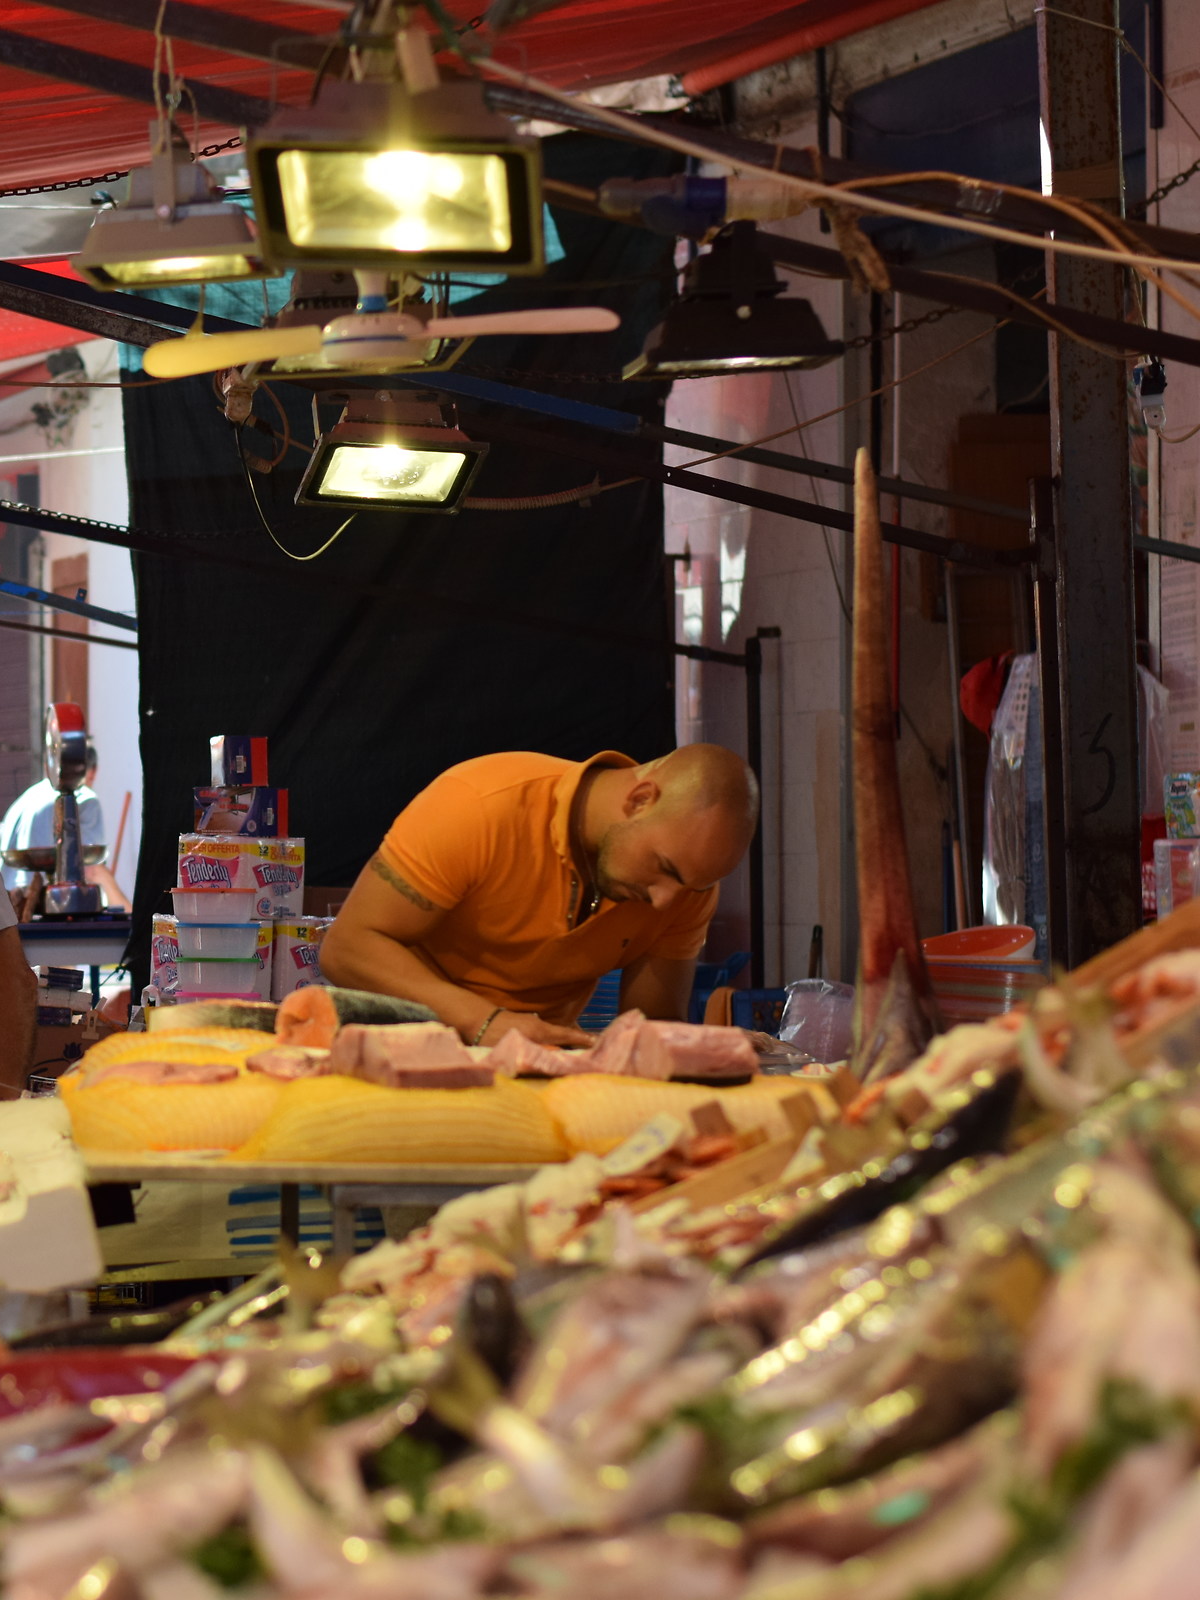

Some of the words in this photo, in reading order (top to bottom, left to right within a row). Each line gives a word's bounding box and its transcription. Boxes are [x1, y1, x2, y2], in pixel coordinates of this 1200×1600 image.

[208, 843, 240, 854] OFFERTA
[182, 855, 232, 889] Tenderly
[257, 864, 300, 889] Tenderly
